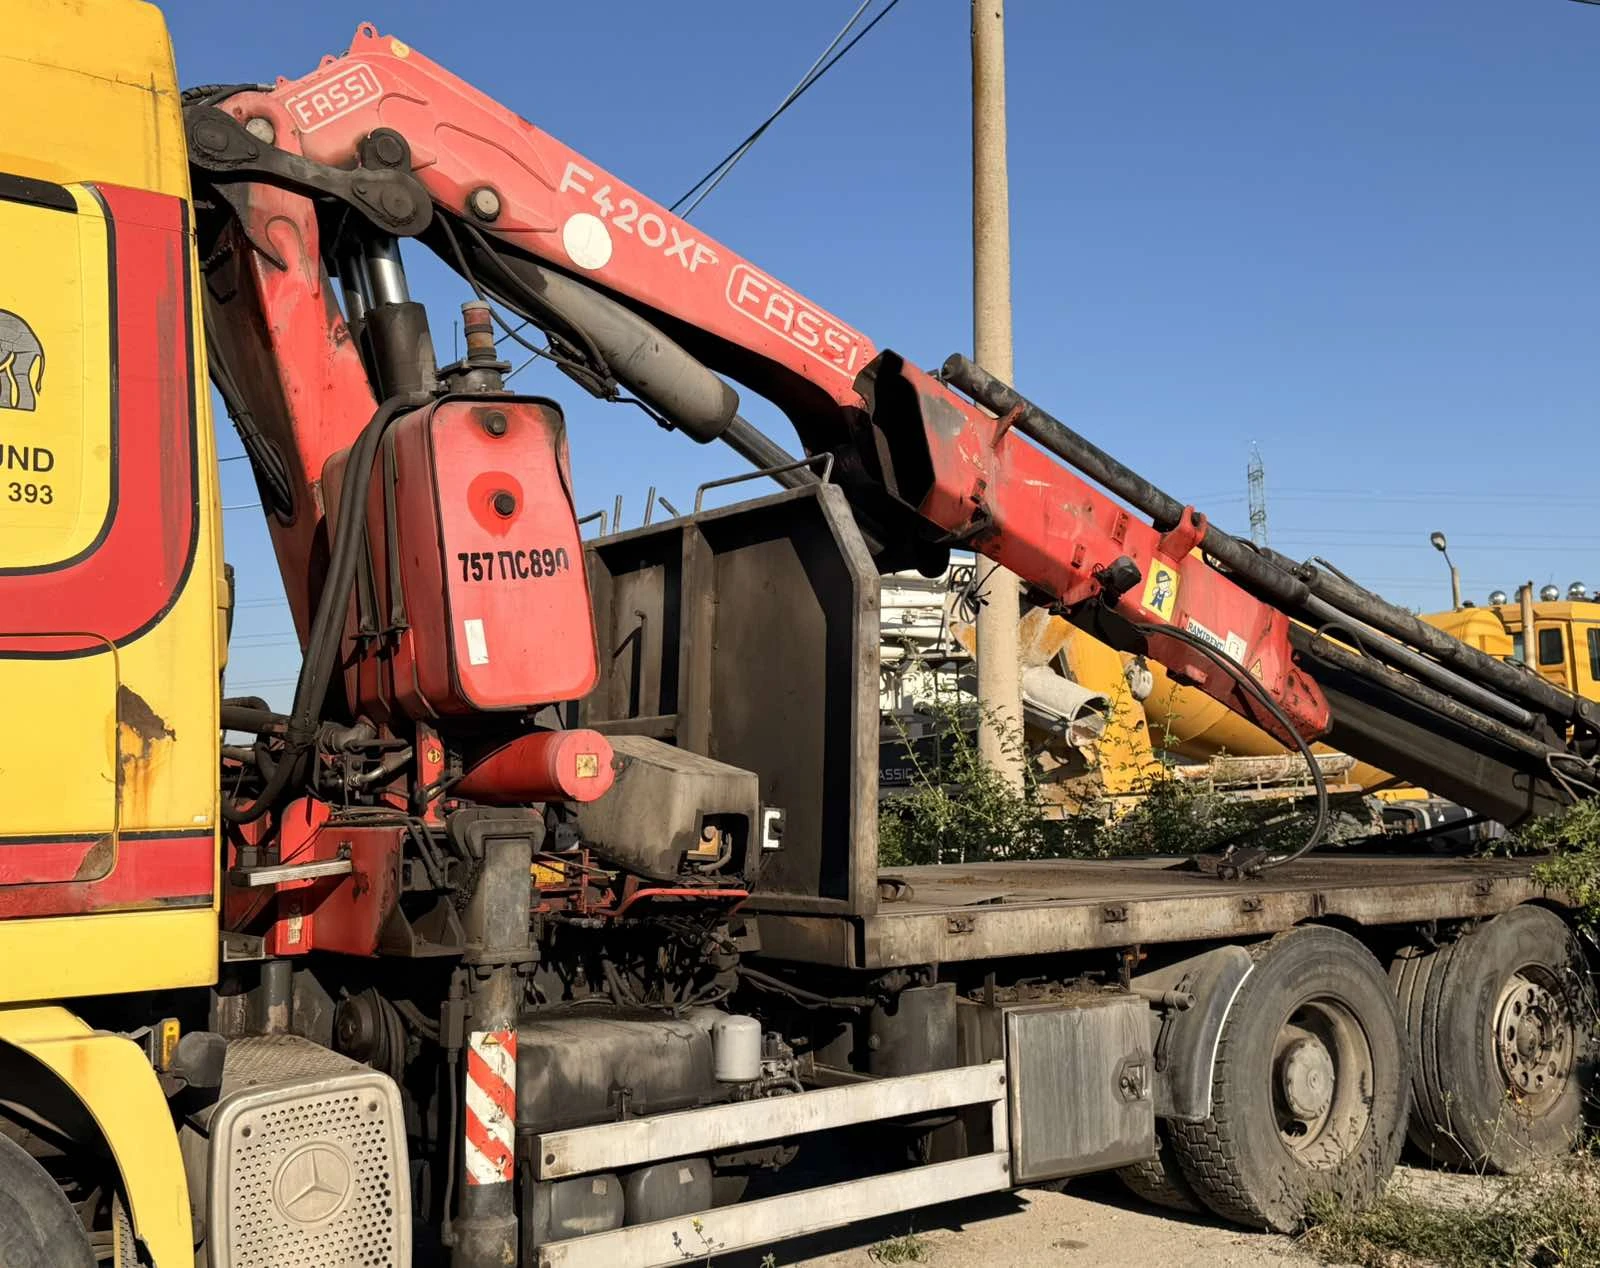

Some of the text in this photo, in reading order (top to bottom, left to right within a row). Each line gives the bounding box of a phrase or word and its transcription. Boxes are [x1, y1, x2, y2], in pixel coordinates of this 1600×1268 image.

[296, 71, 373, 125] FASSI
[737, 274, 858, 371] FASSI
[0, 443, 55, 472] ND
[8, 482, 53, 505] 393
